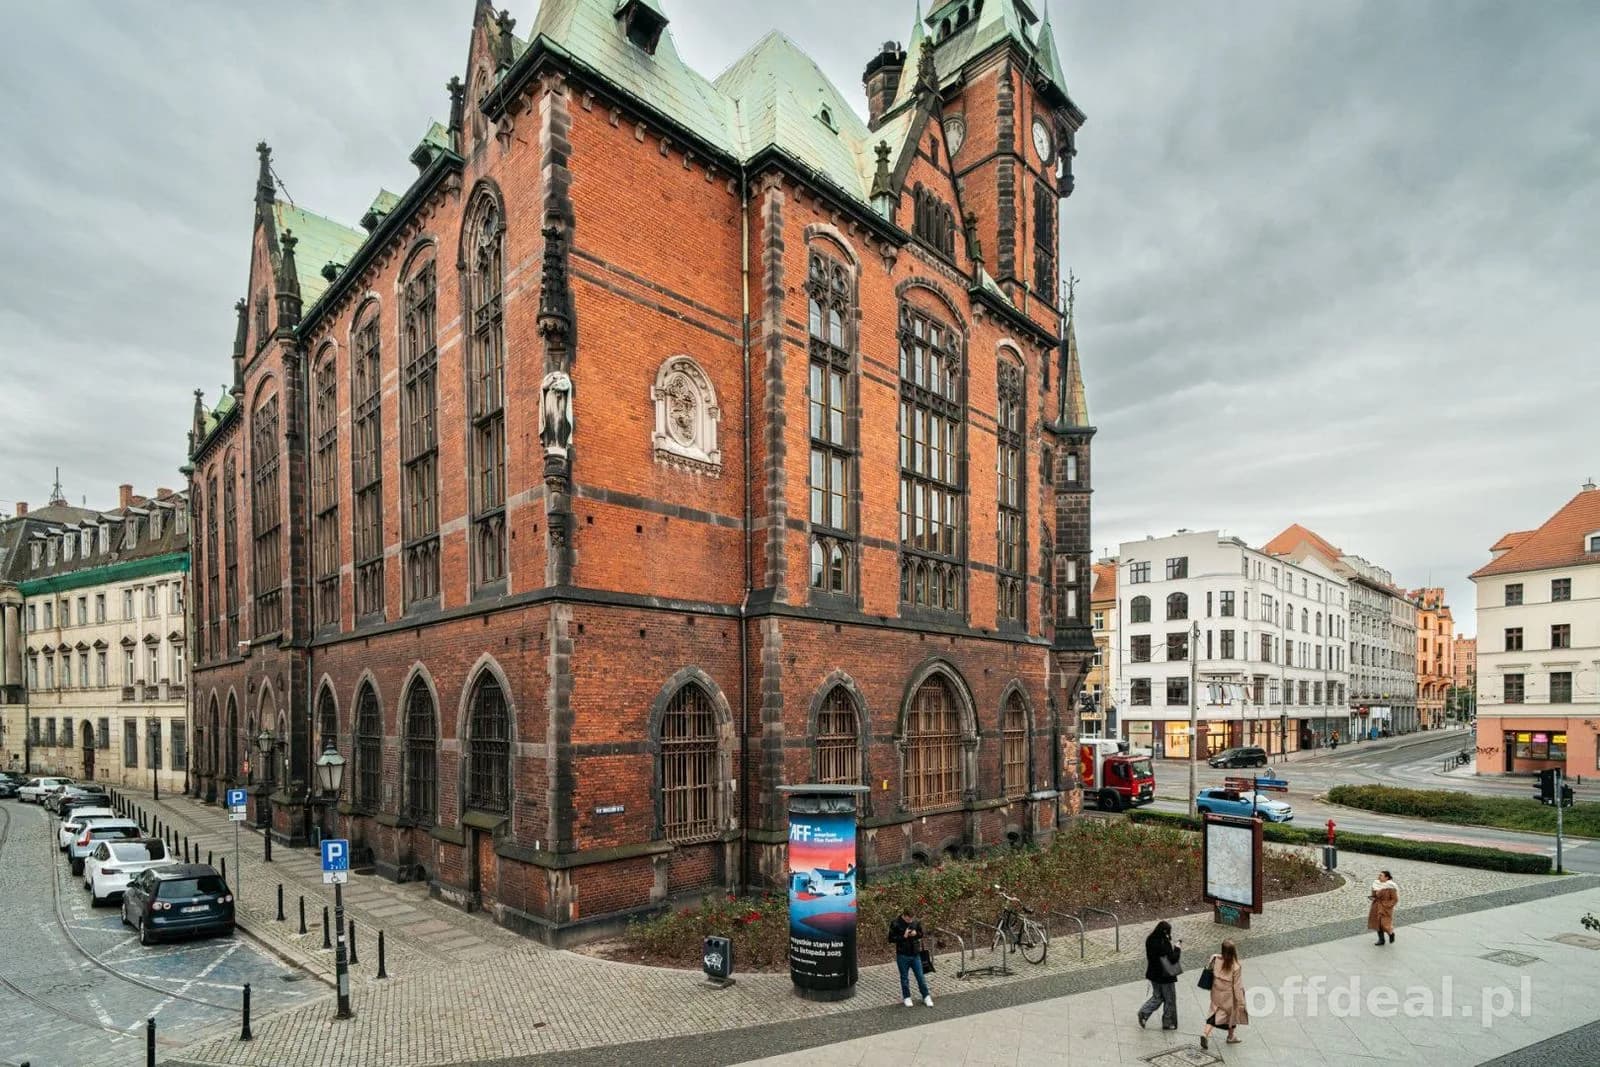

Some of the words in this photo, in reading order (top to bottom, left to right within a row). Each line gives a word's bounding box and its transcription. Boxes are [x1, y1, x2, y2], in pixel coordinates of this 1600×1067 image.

[232, 791, 243, 804] P
[327, 843, 342, 863] P
[813, 941, 830, 949] stany
[799, 946, 826, 957] listopada
